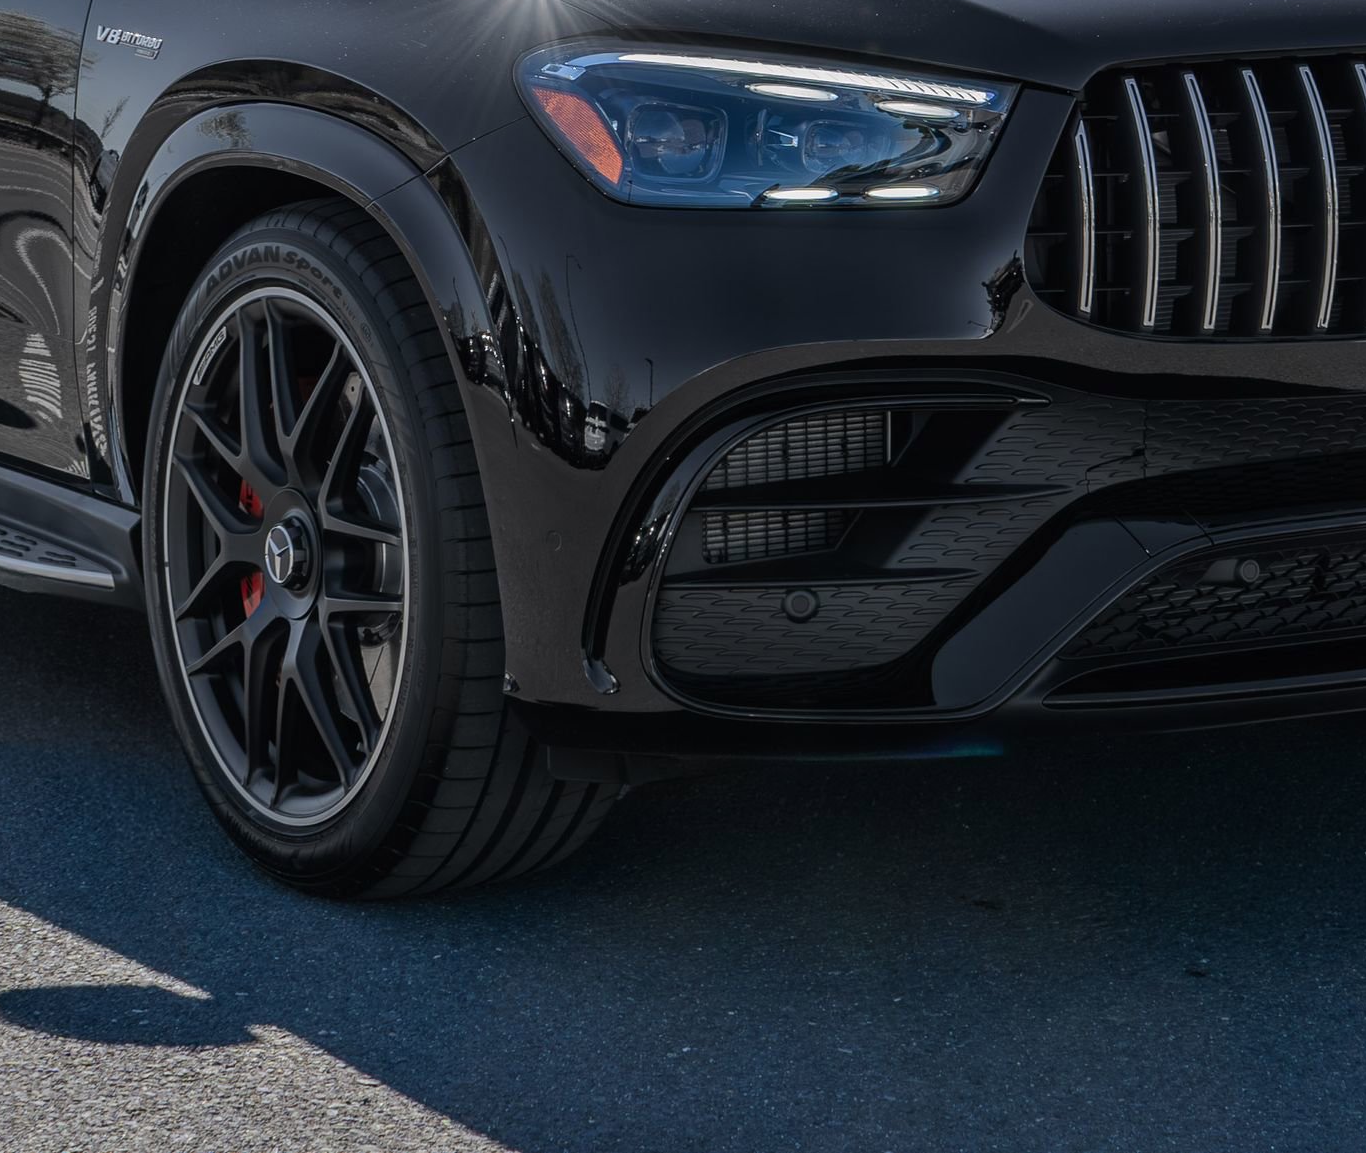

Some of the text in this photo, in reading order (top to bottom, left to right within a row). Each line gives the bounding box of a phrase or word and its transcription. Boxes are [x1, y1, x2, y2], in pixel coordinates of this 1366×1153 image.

[96, 25, 163, 49] V8 BITURBO
[206, 245, 280, 297] ADVAN
